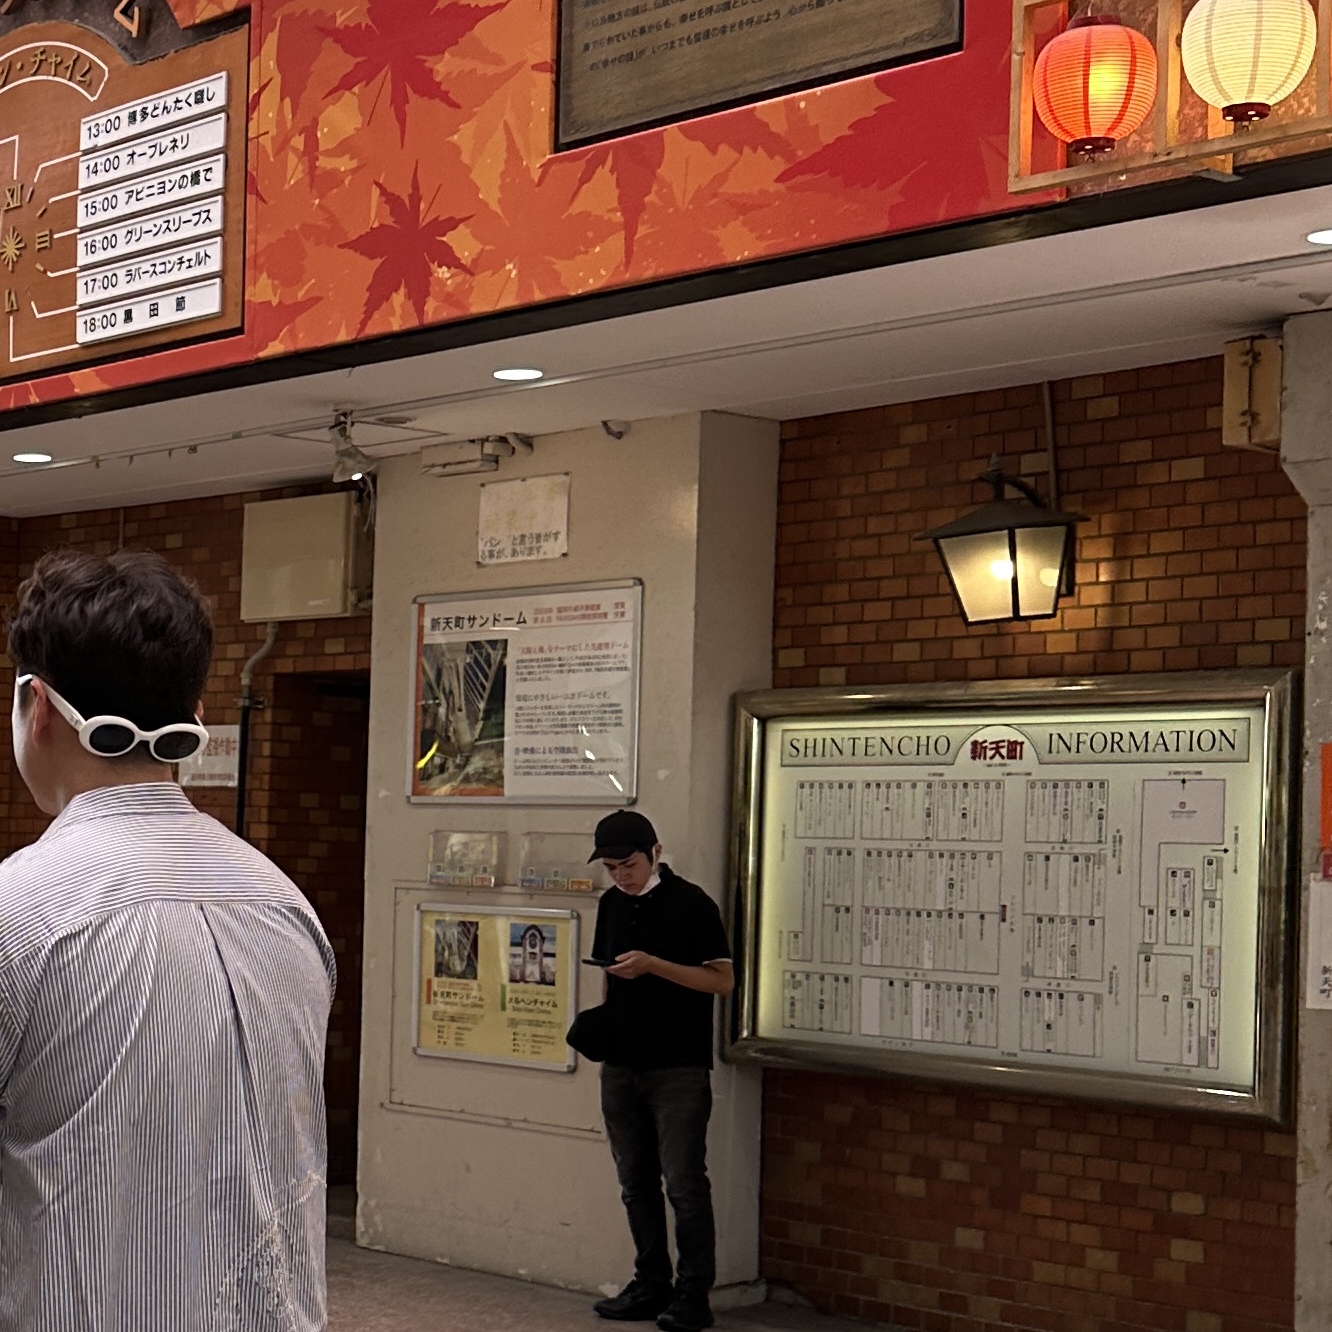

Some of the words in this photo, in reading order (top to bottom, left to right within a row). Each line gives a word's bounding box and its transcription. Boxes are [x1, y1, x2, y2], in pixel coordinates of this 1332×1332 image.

[86, 115, 121, 141] 13:00
[85, 155, 120, 179] 14:00
[84, 194, 118, 218] 15:00
[84, 233, 118, 257] 16:00
[83, 272, 118, 295] 17:00
[83, 312, 117, 334] 18:00
[430, 611, 527, 632] 新天町サンドーム
[788, 735, 951, 758] SHINTENCHO
[970, 738, 1025, 761] 新天町
[1047, 729, 1237, 755] INFORMATION
